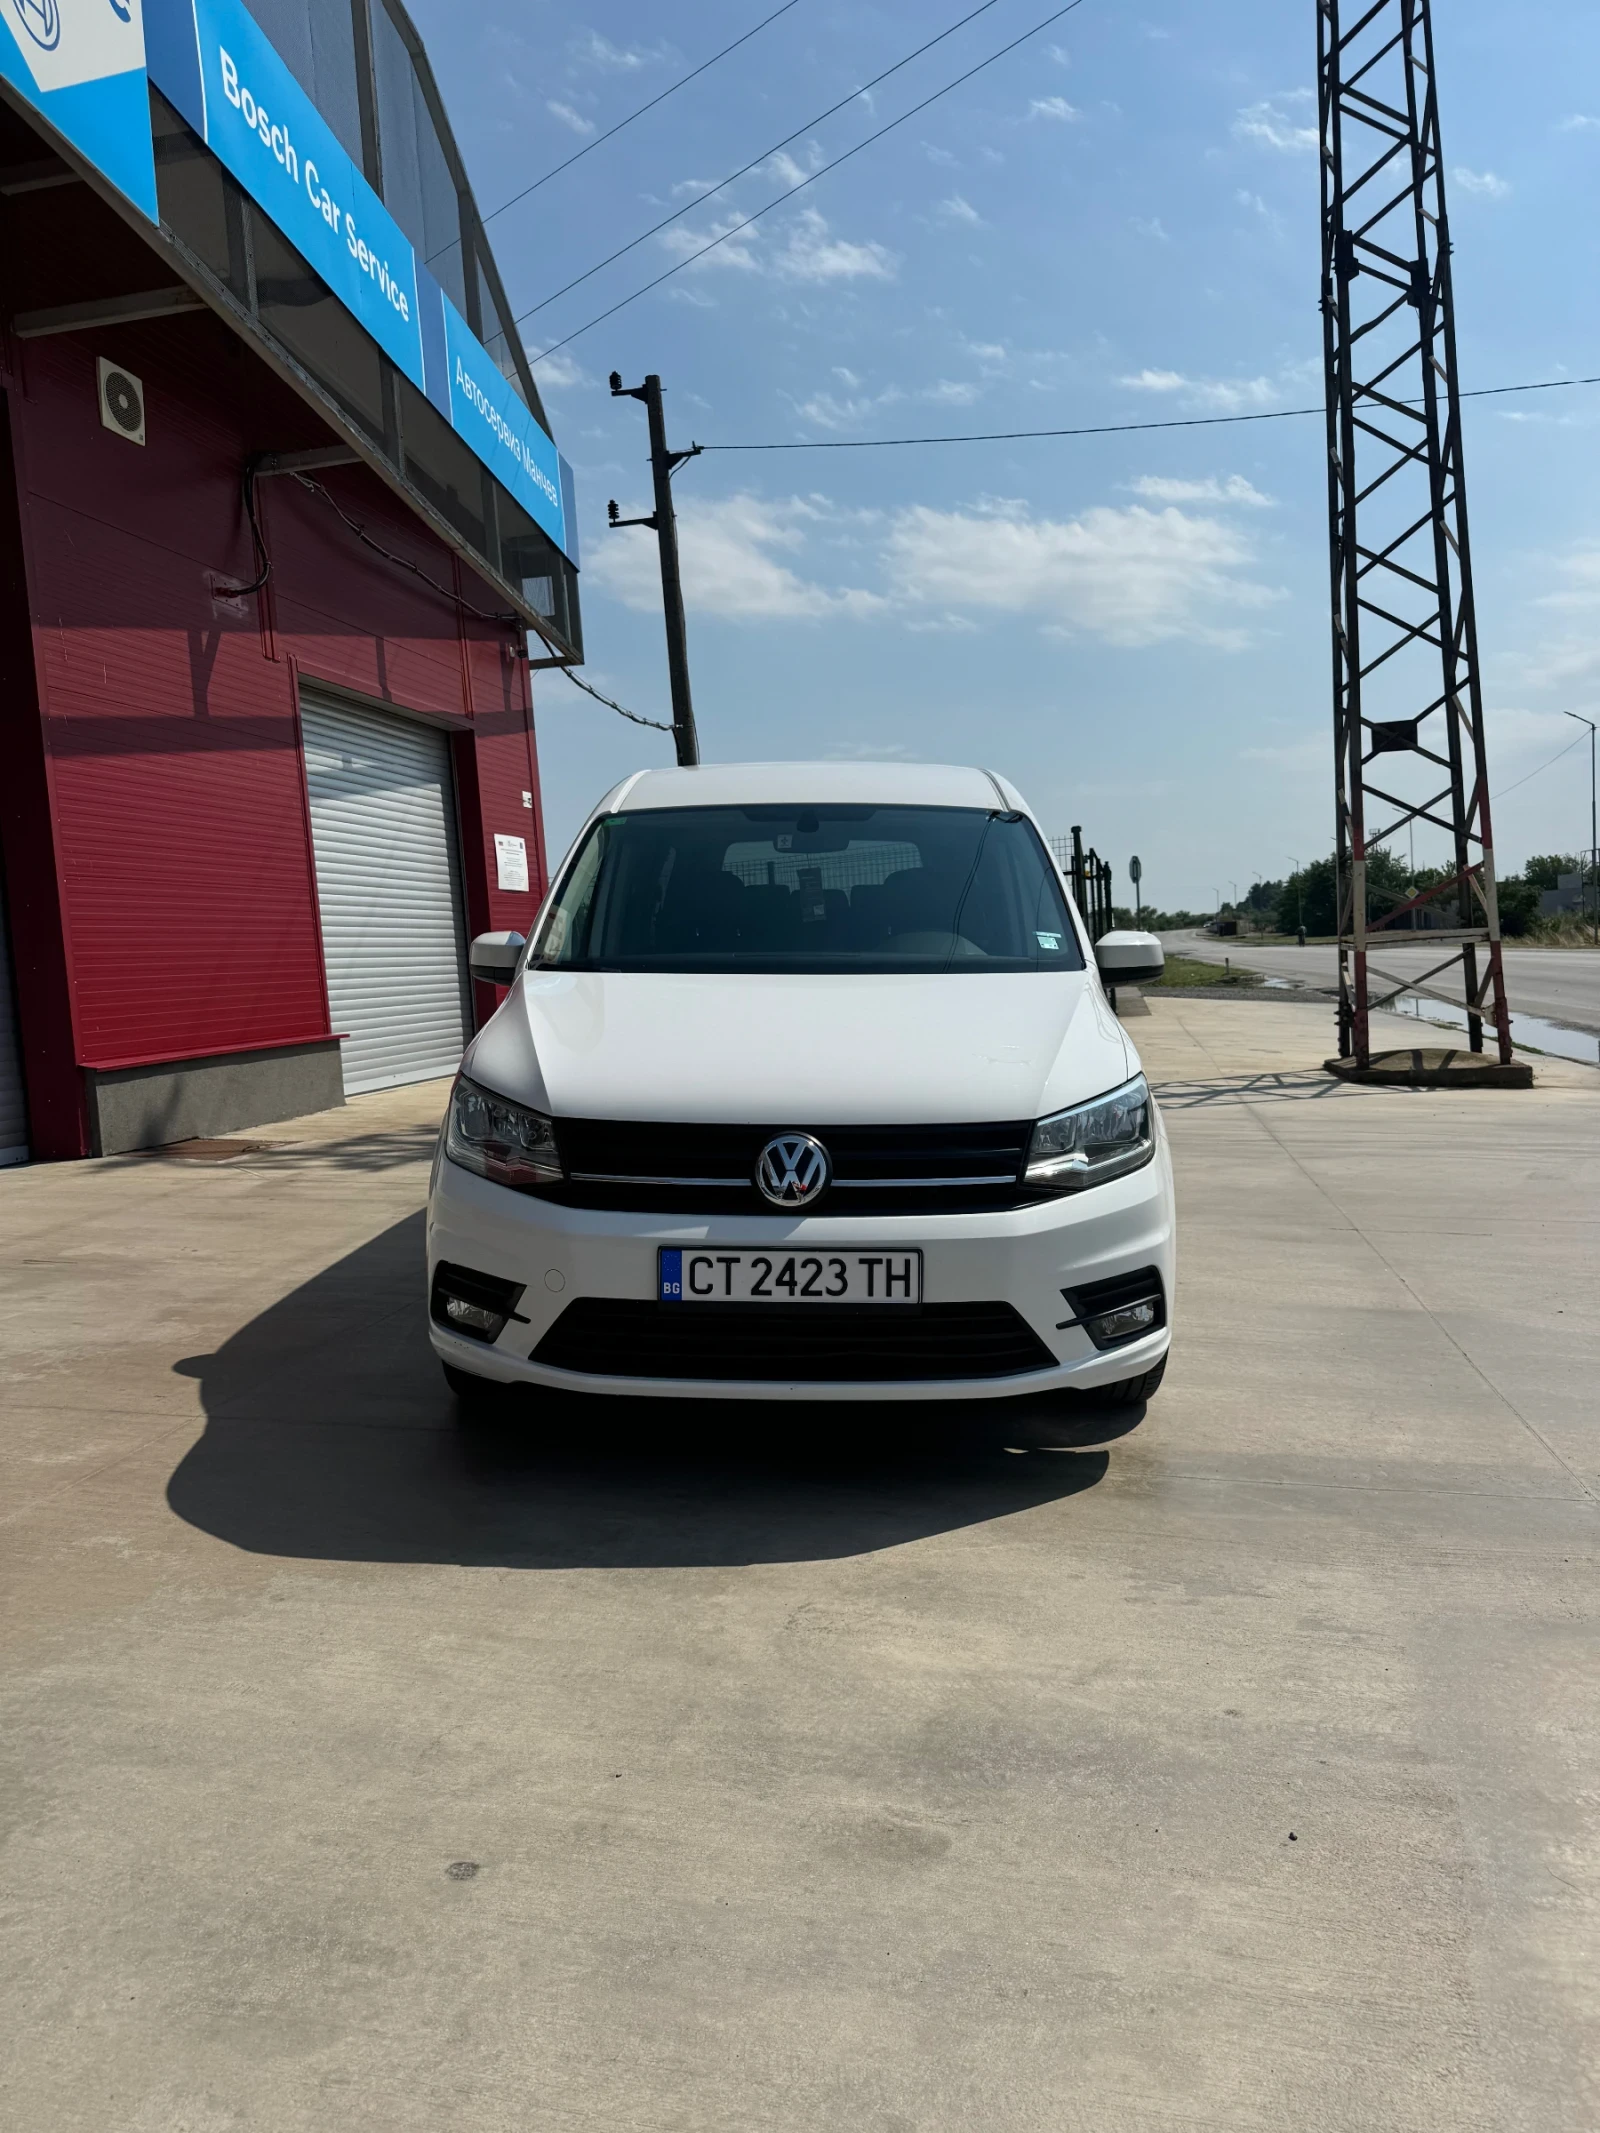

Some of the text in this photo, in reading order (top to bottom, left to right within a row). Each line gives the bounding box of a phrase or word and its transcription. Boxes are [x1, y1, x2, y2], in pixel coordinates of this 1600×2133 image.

[219, 45, 410, 322] Bosch Car Service
[456, 355, 558, 508] Автосервиз Манчев
[663, 1282, 680, 1294] BG
[689, 1256, 911, 1298] CT 2423 TH
